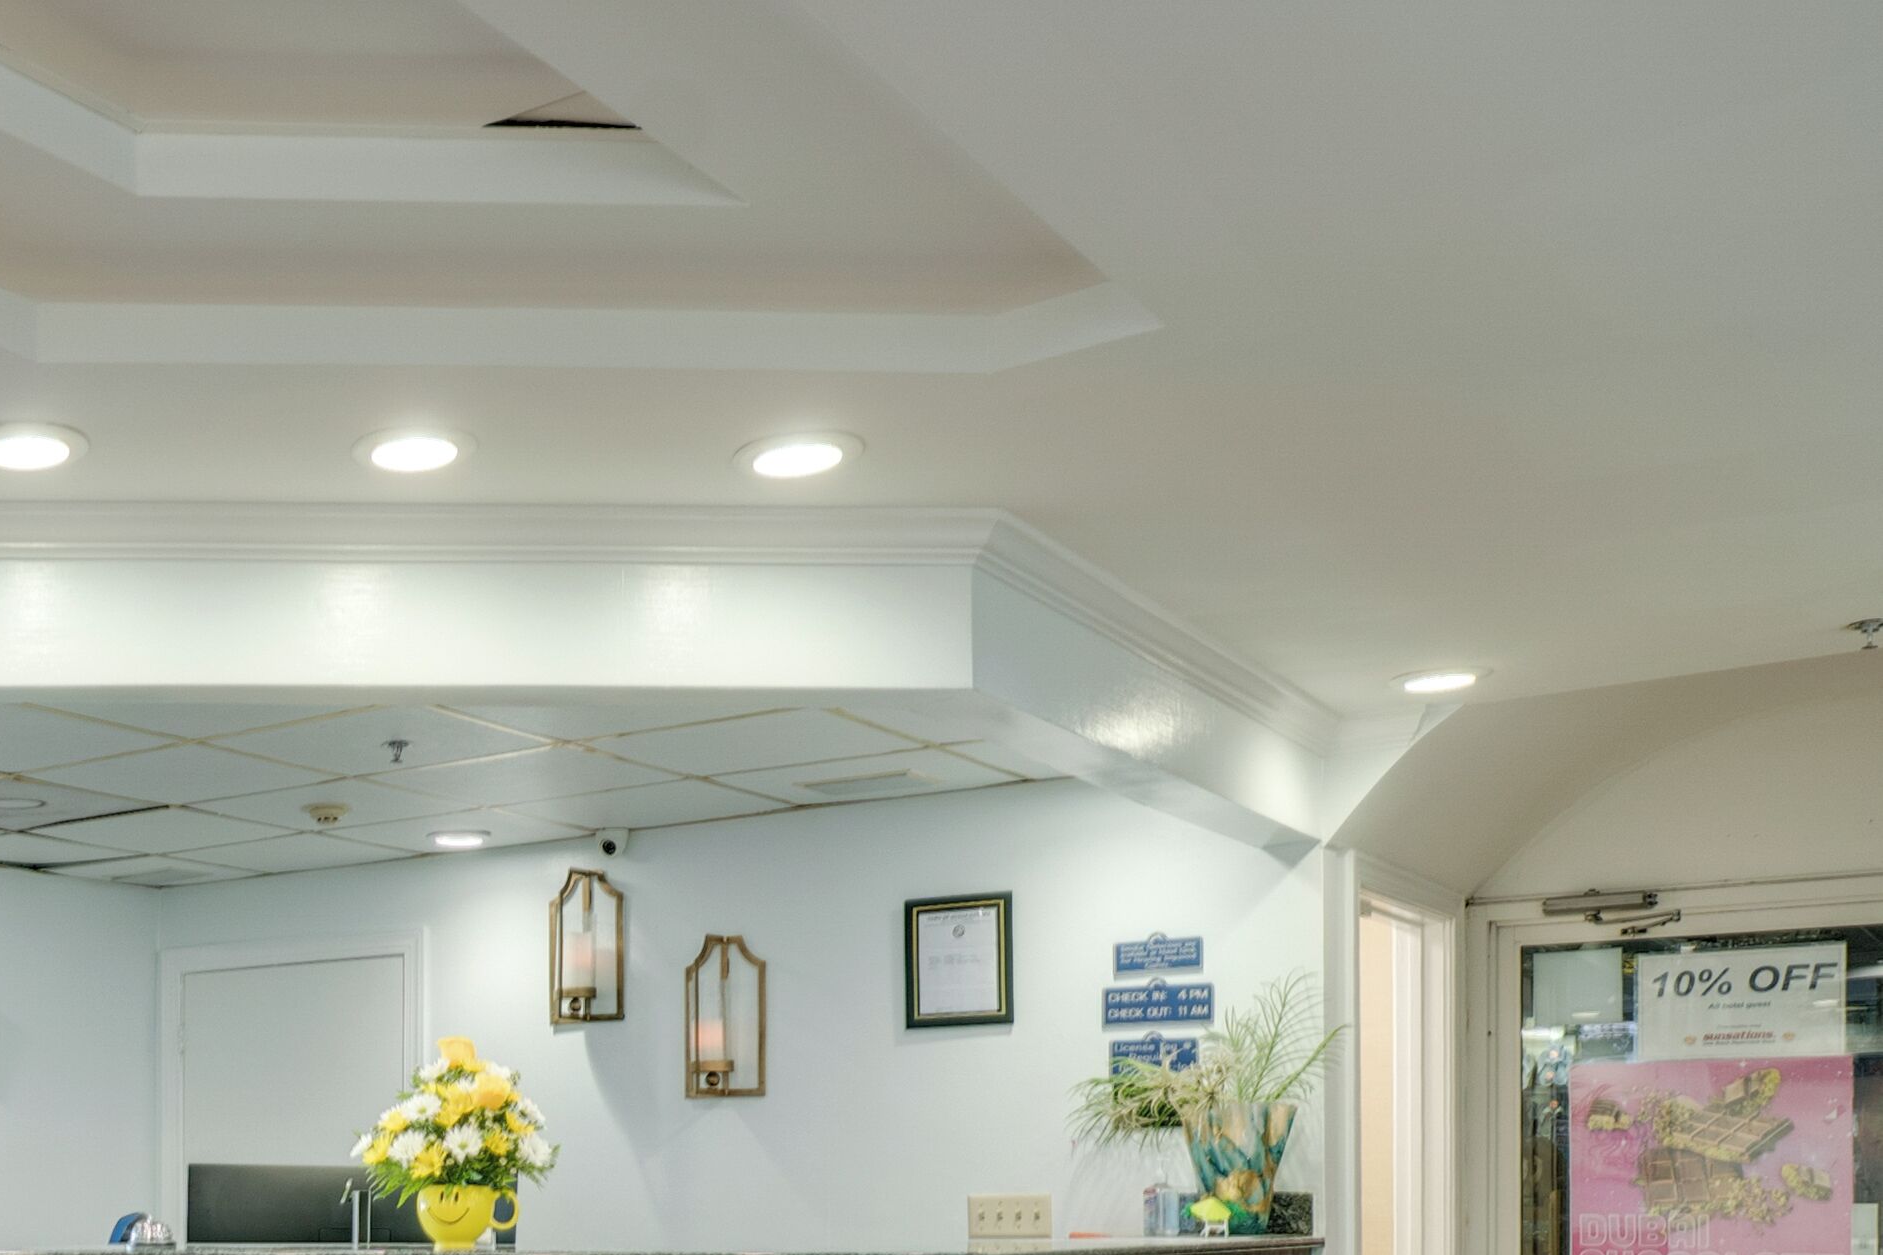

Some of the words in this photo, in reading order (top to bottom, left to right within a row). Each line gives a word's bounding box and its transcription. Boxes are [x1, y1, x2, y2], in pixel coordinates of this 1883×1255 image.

[1653, 967, 1733, 998] 10%
[1749, 962, 1839, 993] OFF
[1108, 991, 1148, 1003] CHECK
[1177, 989, 1188, 1001] 4
[1189, 988, 1209, 1000] PM
[1108, 1007, 1144, 1018] CHECK
[1178, 1005, 1188, 1016] 11
[1190, 1004, 1209, 1016] AM
[1579, 1214, 1711, 1248] DUBAI
